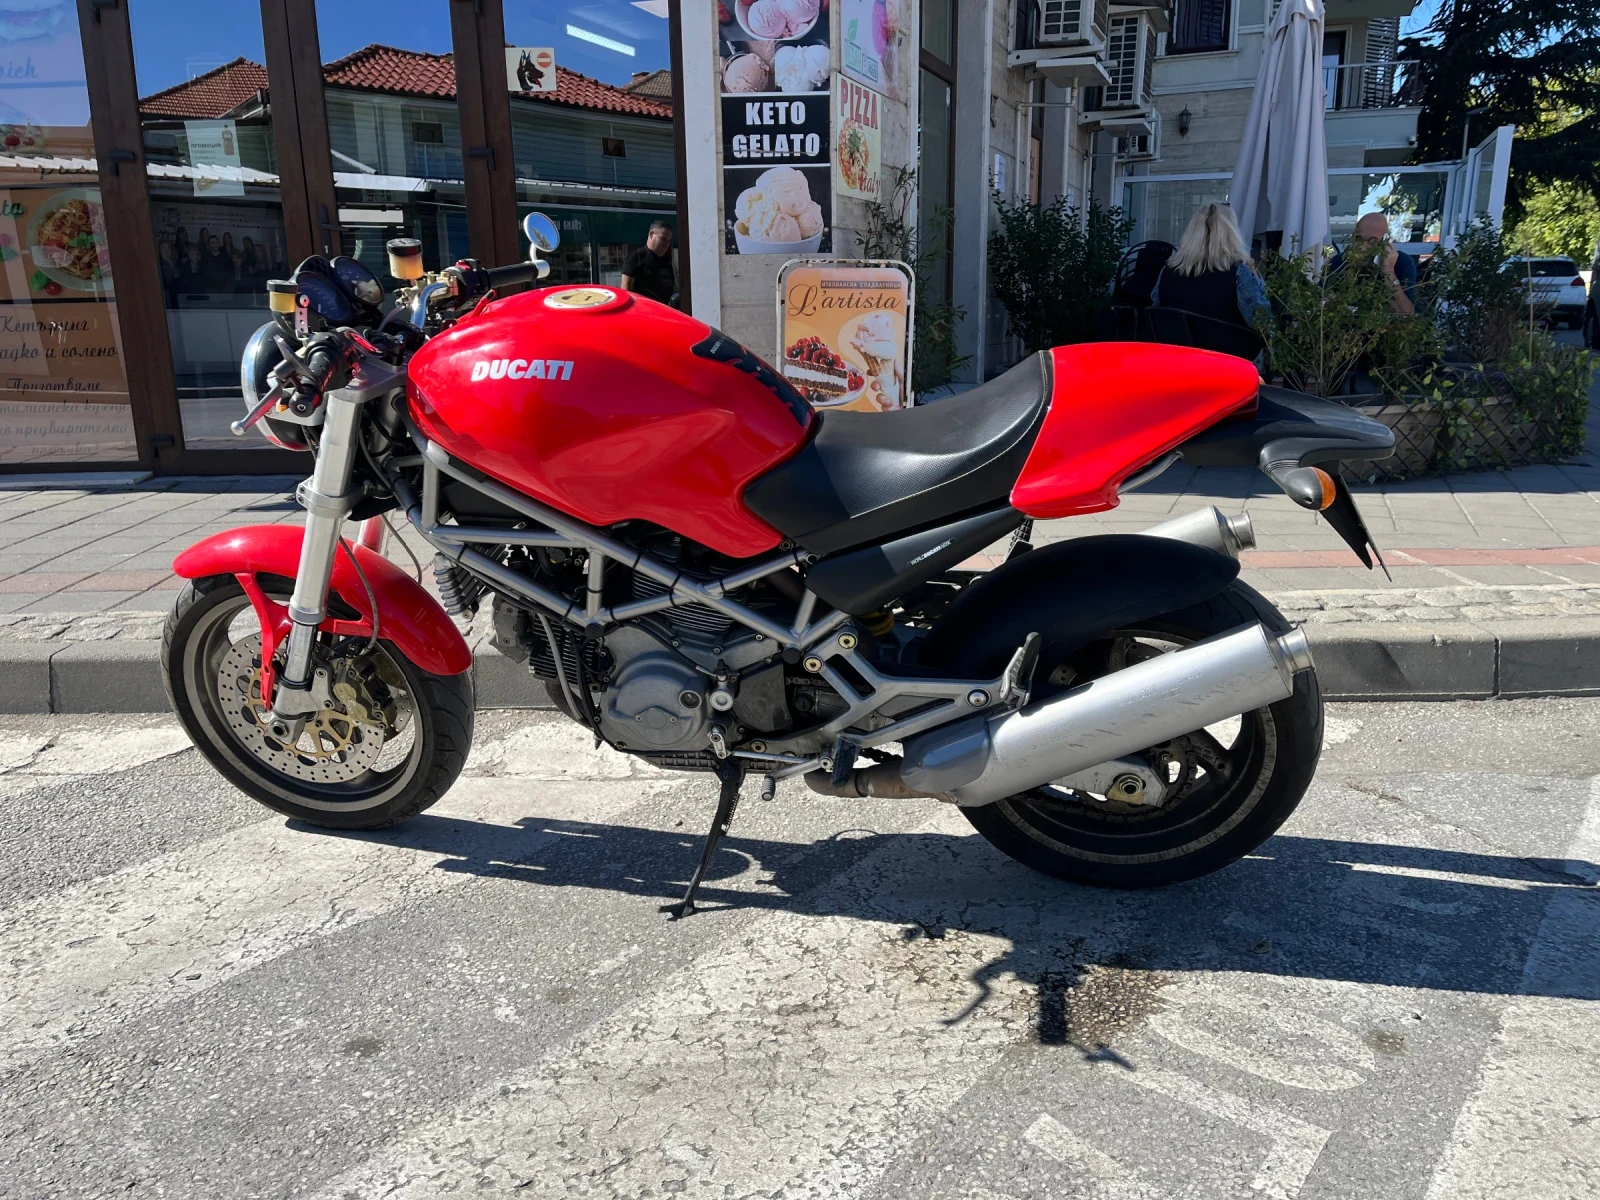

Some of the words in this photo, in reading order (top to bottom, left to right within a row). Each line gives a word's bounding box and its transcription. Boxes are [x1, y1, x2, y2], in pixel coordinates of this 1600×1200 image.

[745, 101, 806, 126] KETO
[840, 78, 879, 130] PIZZA
[732, 133, 821, 158] GELATO
[860, 281, 901, 289] СЛАДКАРНИЦА
[788, 283, 901, 316] L'artista
[0, 316, 90, 336] Кетъринг
[45, 348, 58, 358] и
[62, 346, 118, 359] солено
[471, 359, 574, 382] DUCATI
[6, 377, 102, 395] Приготвяме
